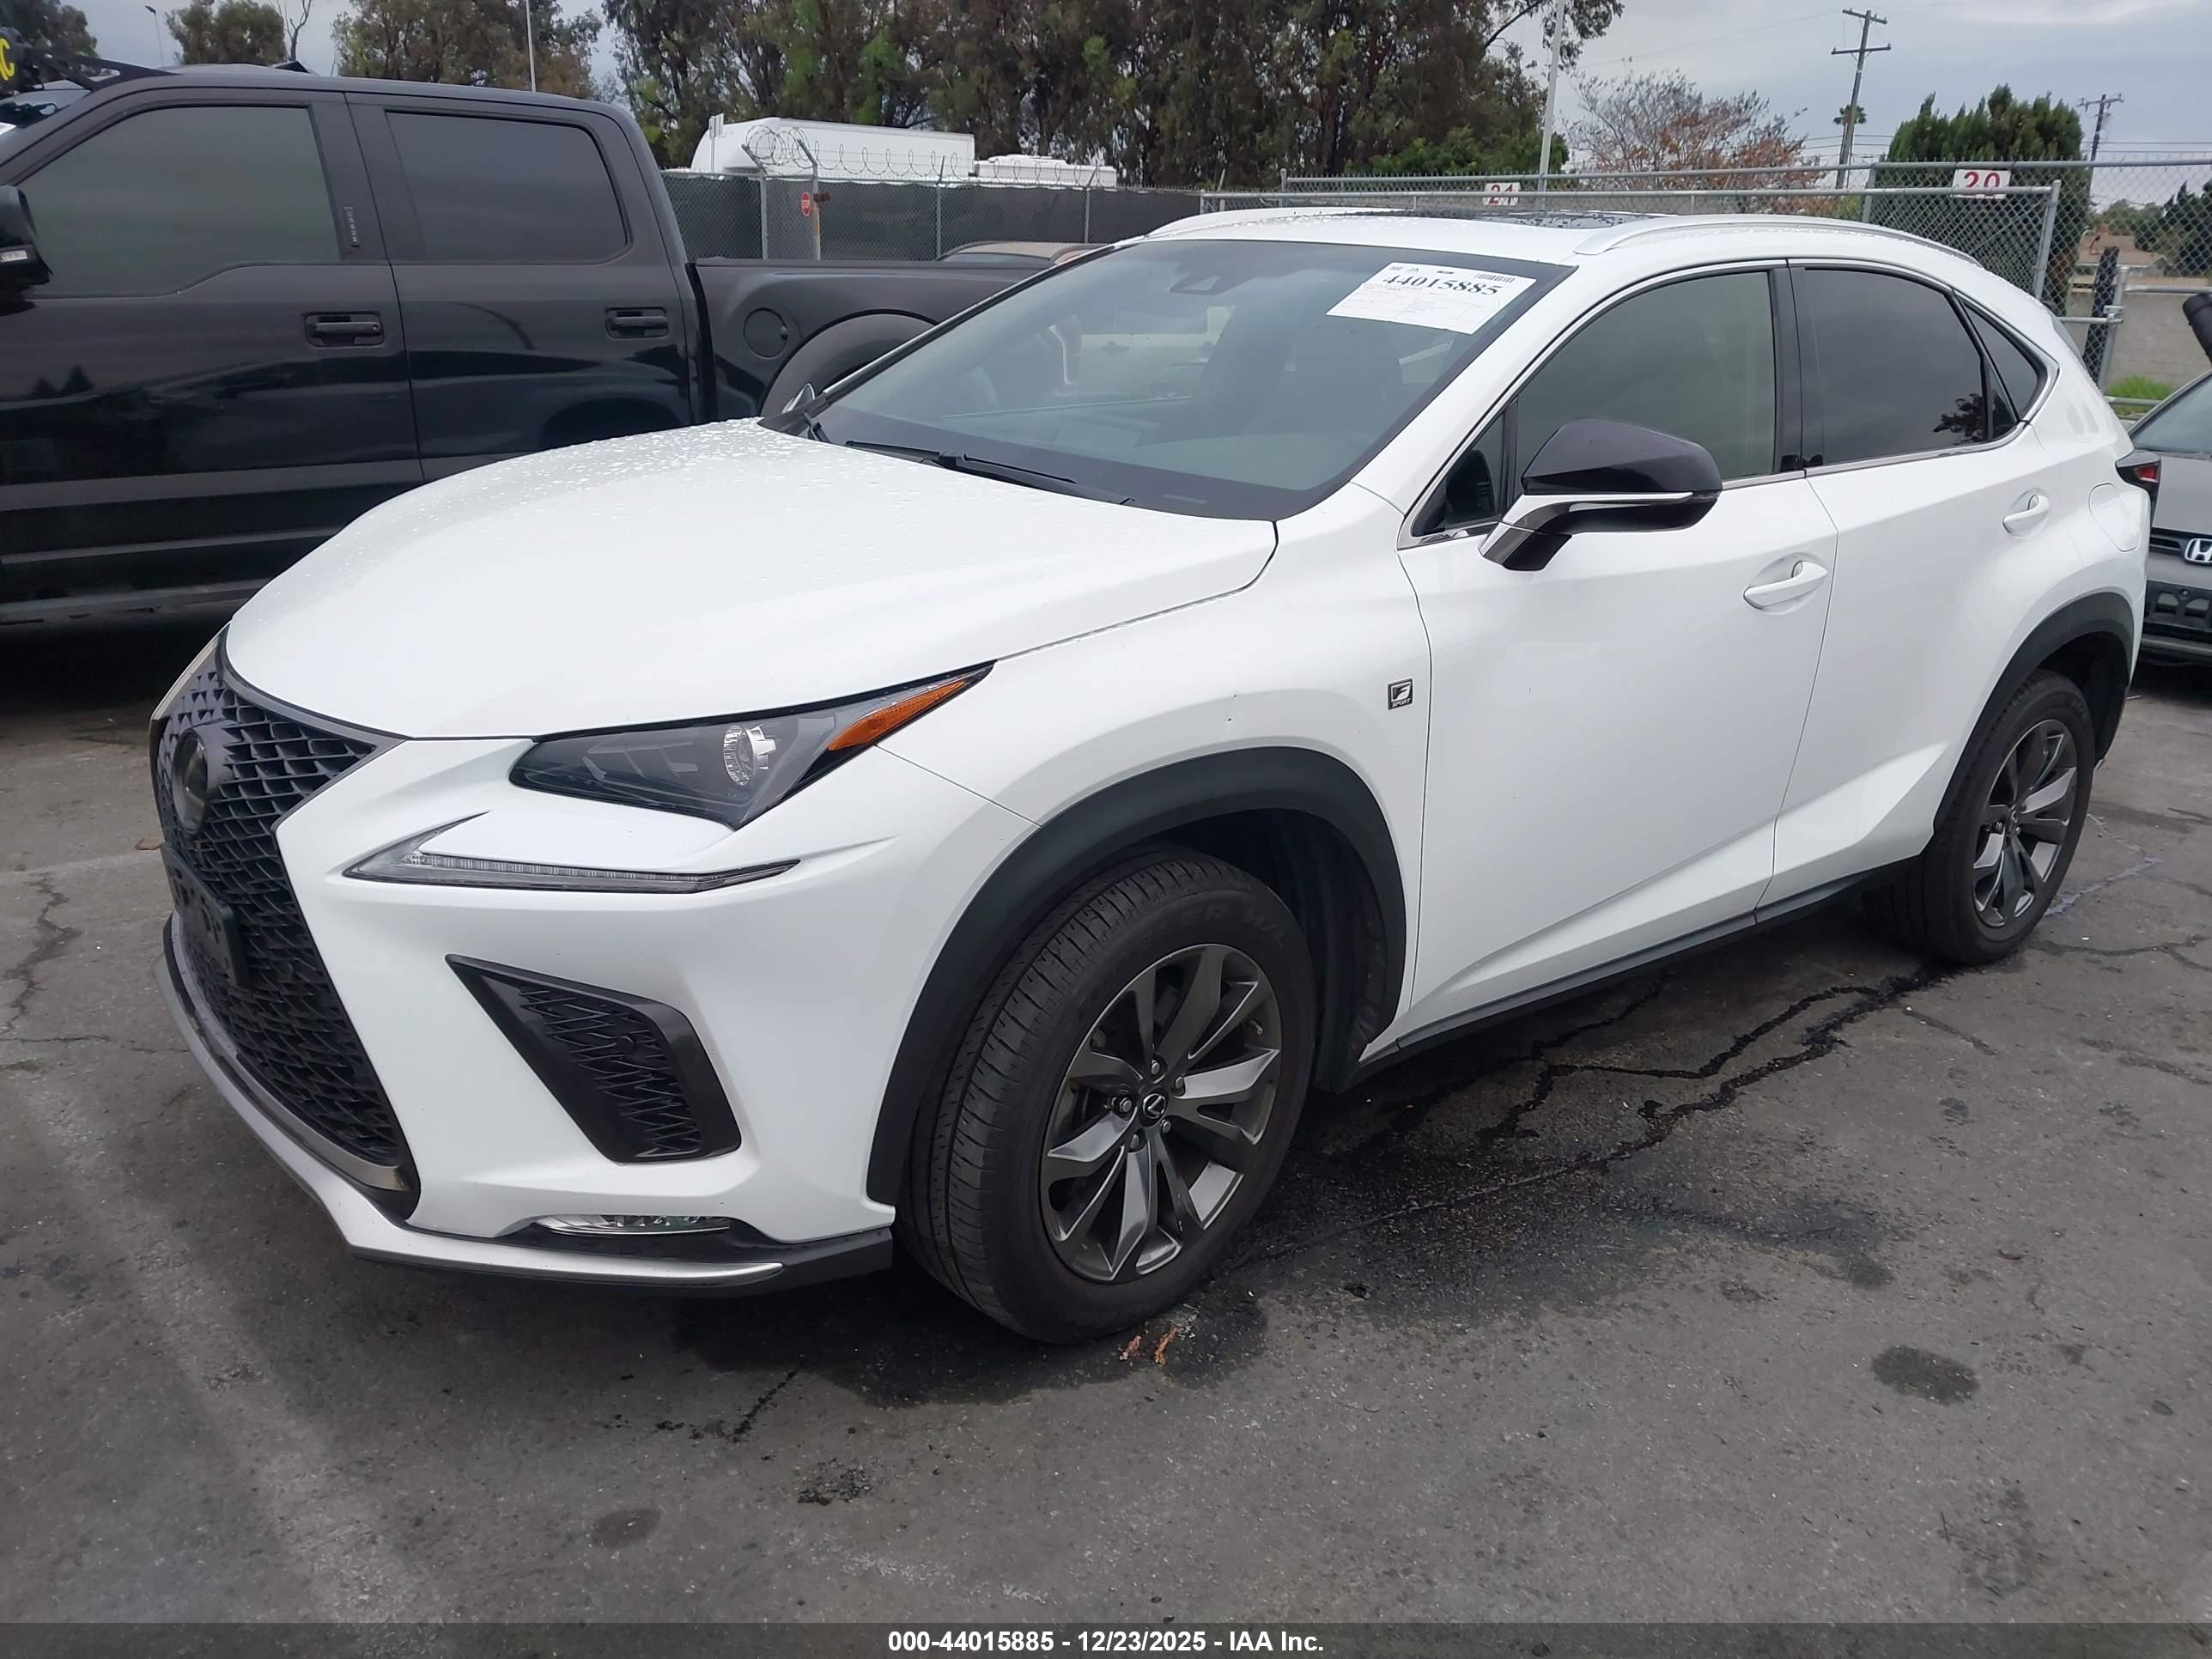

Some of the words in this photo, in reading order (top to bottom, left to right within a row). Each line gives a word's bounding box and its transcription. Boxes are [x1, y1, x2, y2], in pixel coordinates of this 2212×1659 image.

[1488, 183, 1514, 206] 24
[1963, 171, 2002, 197] 20
[1382, 274, 1504, 295] 44015885
[1391, 697, 1412, 708] SPORT
